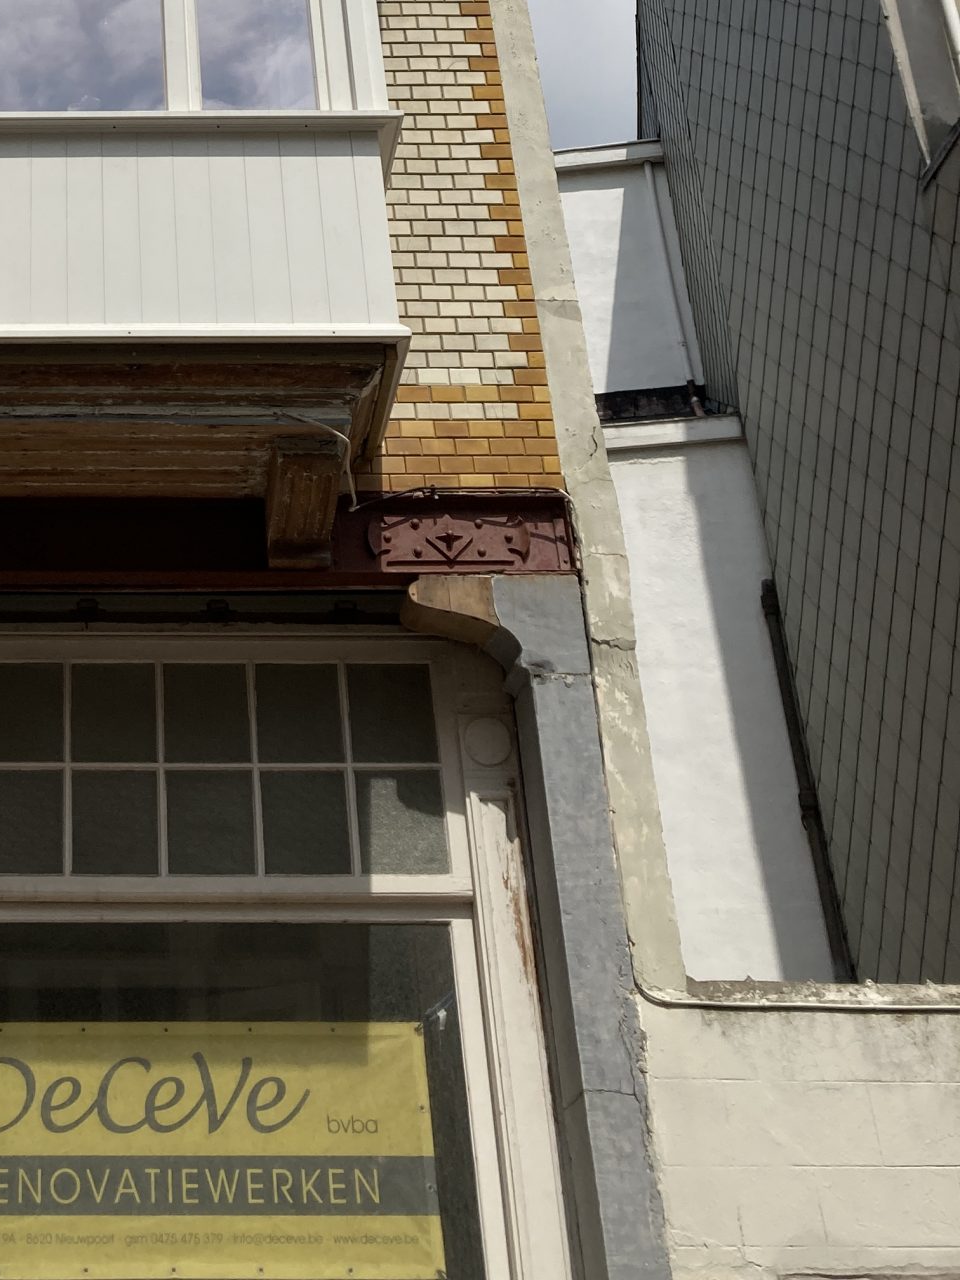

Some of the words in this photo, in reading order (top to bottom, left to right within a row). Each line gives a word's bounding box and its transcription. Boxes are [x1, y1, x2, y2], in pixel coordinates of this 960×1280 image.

[326, 1114, 379, 1135] bvba
[2, 1233, 16, 1243] 9A
[26, 1233, 53, 1244] 8620
[56, 1233, 115, 1247] Nieuwpoort
[124, 1235, 148, 1247] gsm
[151, 1233, 176, 1244] 0475
[181, 1233, 201, 1244] 475
[204, 1233, 223, 1244] 379
[233, 1233, 323, 1245] info@deceve.be
[333, 1233, 419, 1244] www.deceve.be
